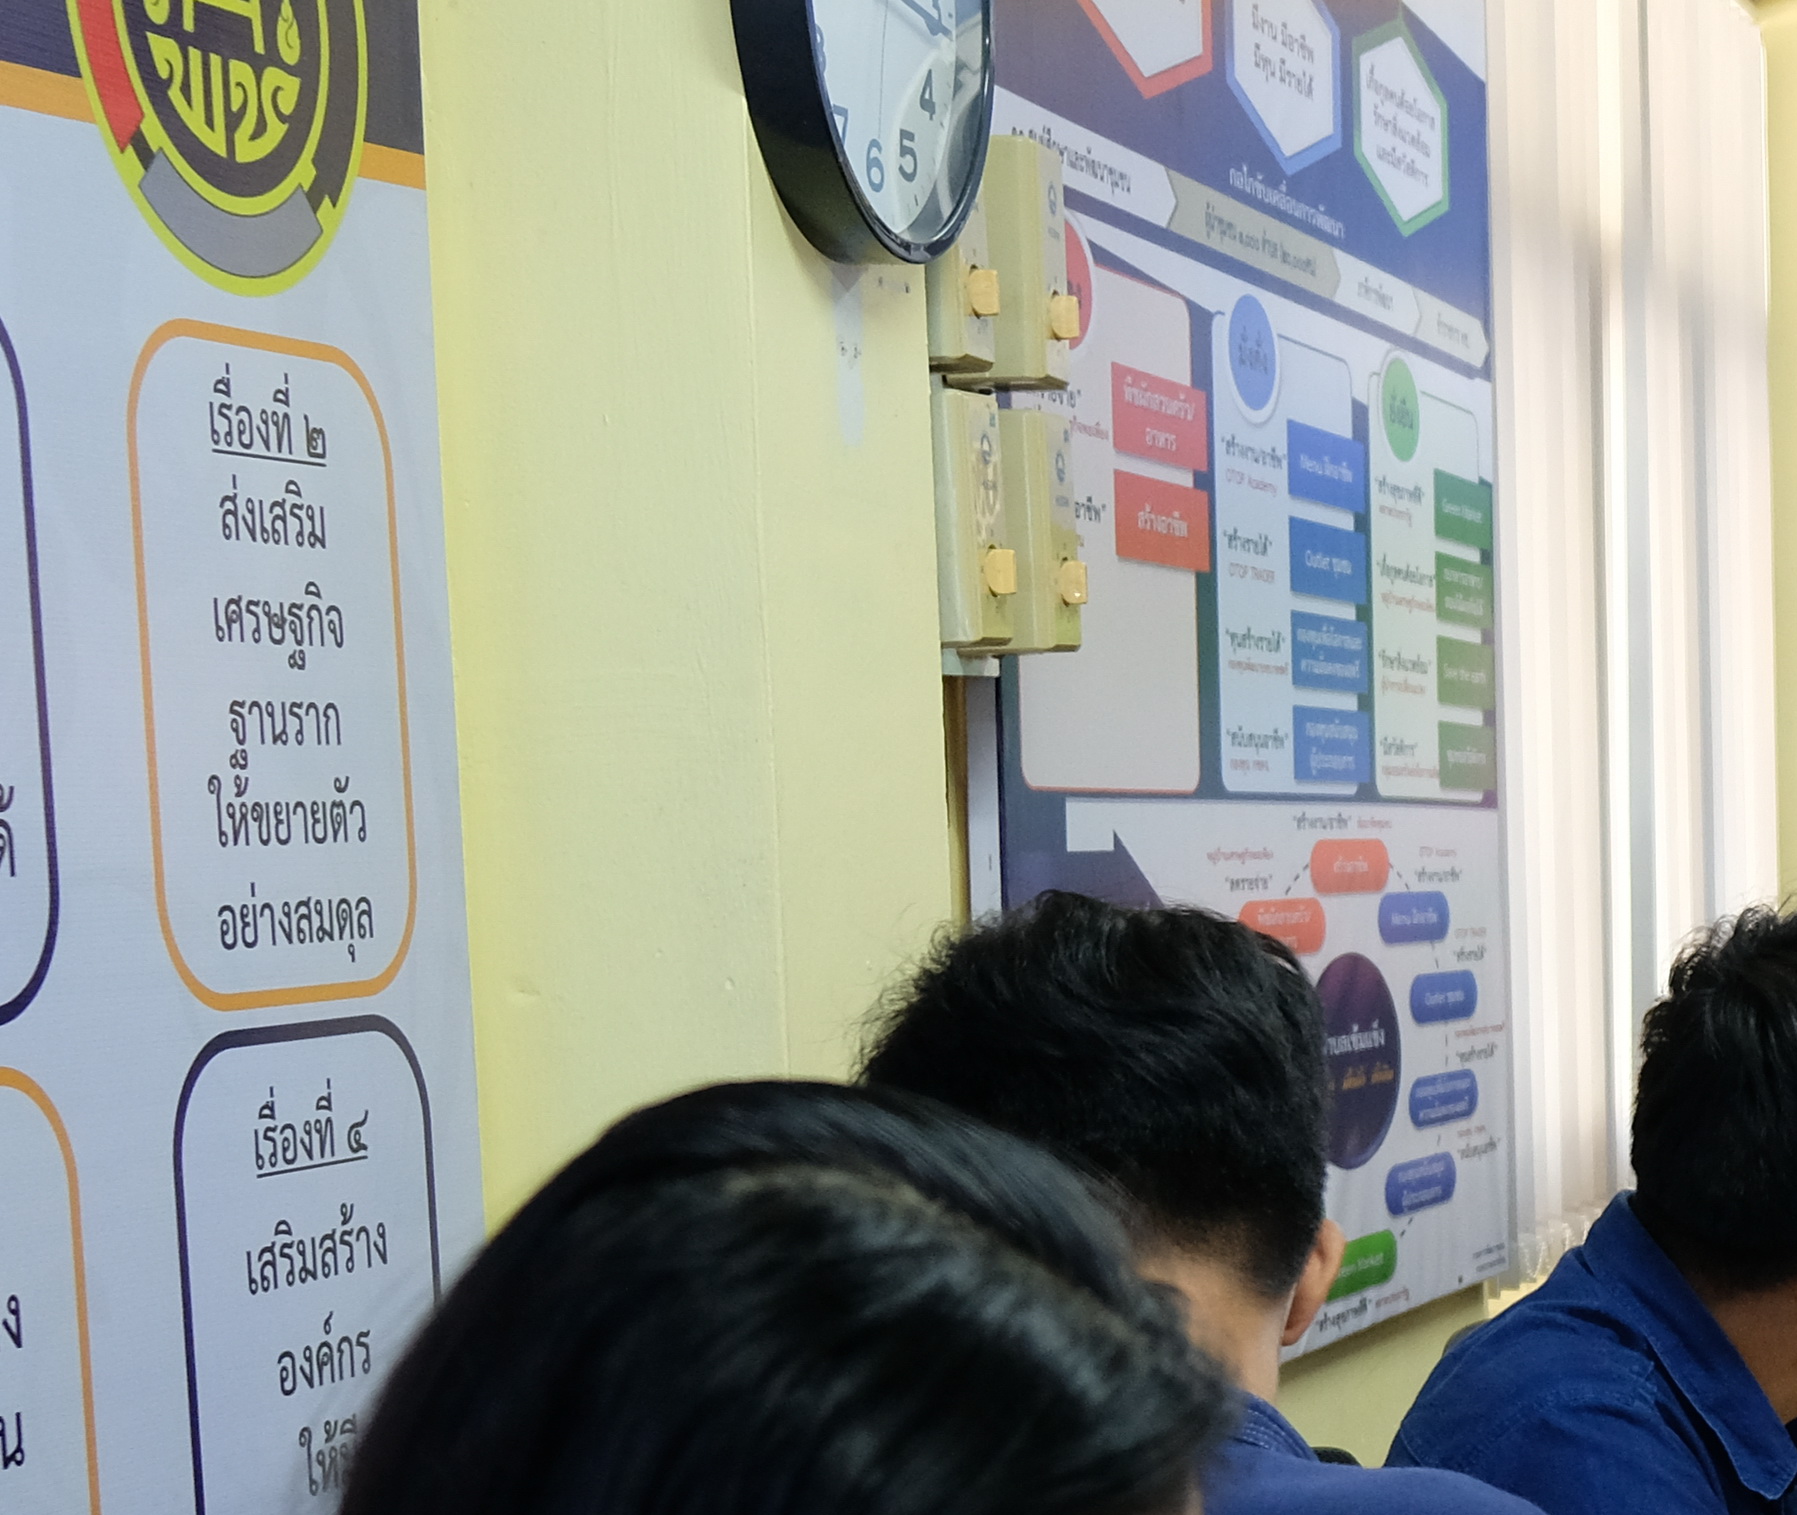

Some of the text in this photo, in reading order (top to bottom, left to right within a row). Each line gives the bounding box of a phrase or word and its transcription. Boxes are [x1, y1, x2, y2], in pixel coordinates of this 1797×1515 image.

[1279, 56, 1314, 101] มีรายได้
[1281, 21, 1314, 64] มีอาชีพ
[919, 68, 936, 121] 4
[866, 138, 884, 193] 6
[899, 128, 917, 183] 5
[209, 363, 327, 461] เรื่องที่ ๒
[1145, 427, 1177, 452] อาหาร
[219, 472, 328, 551] ส่งเสริม
[1137, 503, 1189, 538] สร้างอาชีพ
[213, 592, 346, 670] เศรษฐกิจ
[228, 695, 342, 770] ฐานราก
[207, 773, 368, 848] ให้ขยายตัว
[216, 881, 376, 963] อย่างสมดุล
[254, 1078, 370, 1170] เรื่องที่ ๔
[245, 1202, 390, 1298] เสริมสร้าง
[276, 1311, 372, 1397] องค์กร
